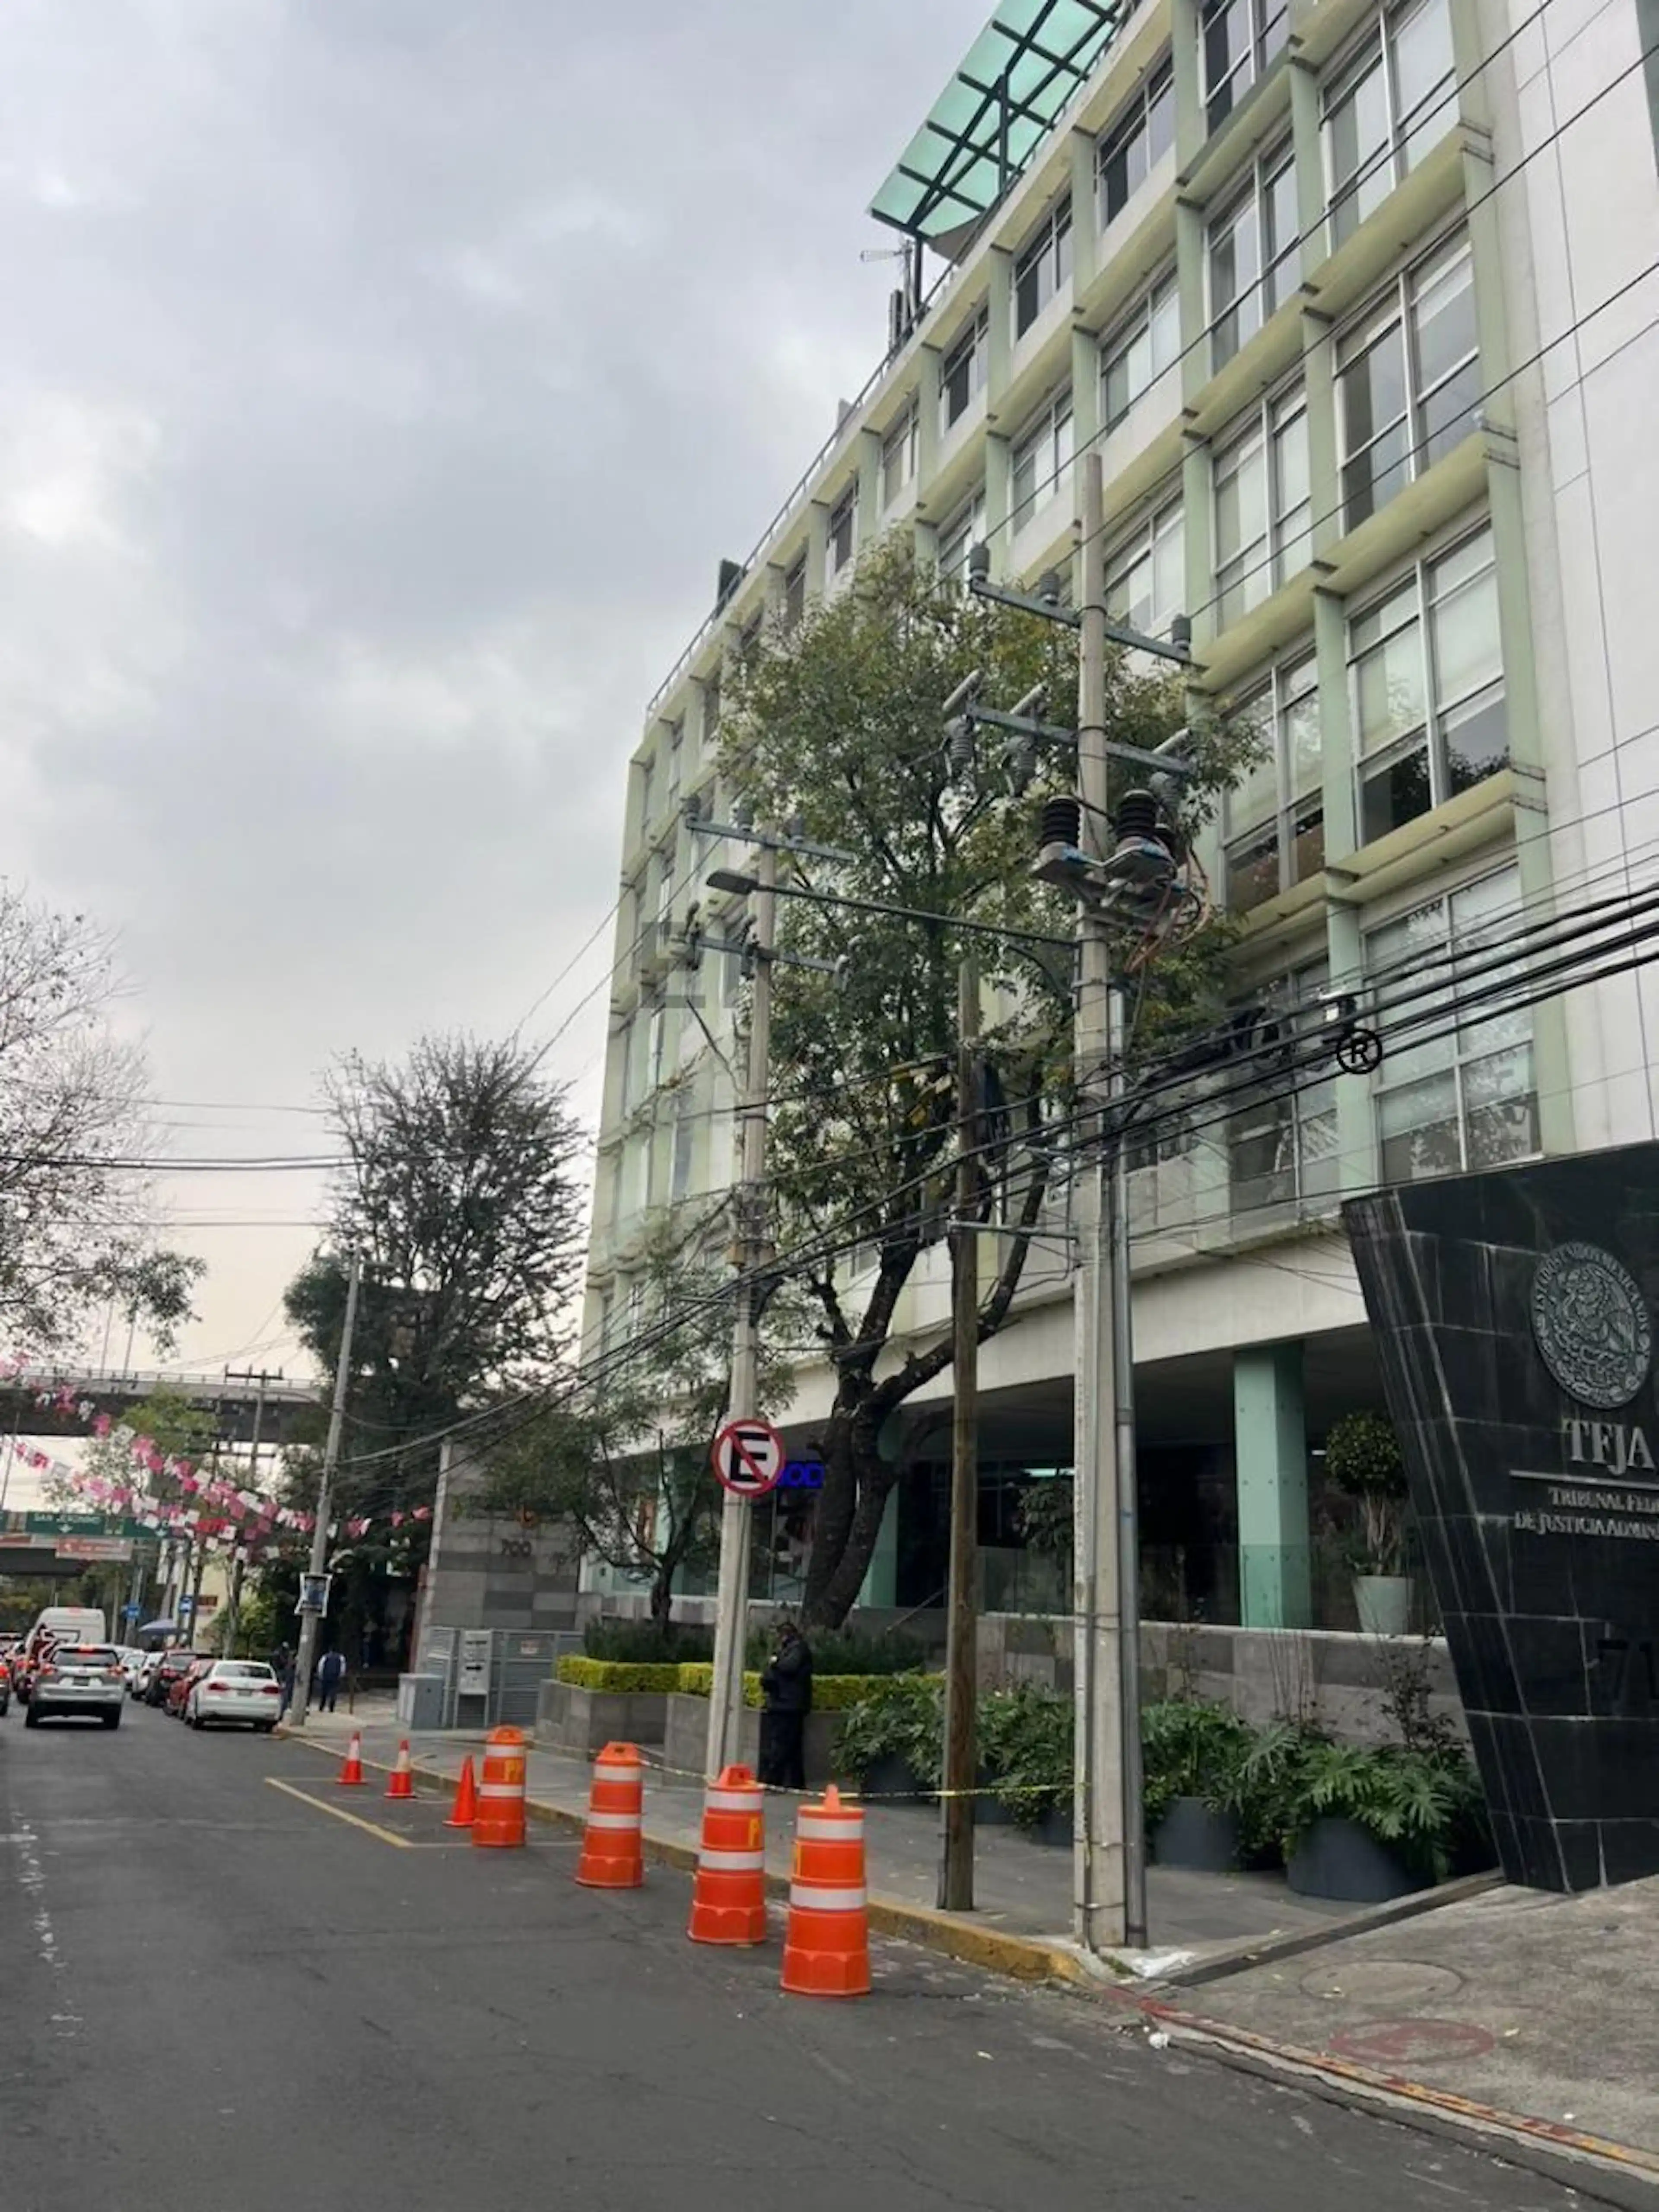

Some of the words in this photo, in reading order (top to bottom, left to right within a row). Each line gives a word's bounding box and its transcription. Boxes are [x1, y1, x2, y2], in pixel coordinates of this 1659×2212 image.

[1561, 1417, 1655, 1476] TFJA
[1548, 1487, 1625, 1510] TRIBUNAL
[1514, 1511, 1536, 1529] DE
[1537, 1512, 1606, 1535] JUSTICIA
